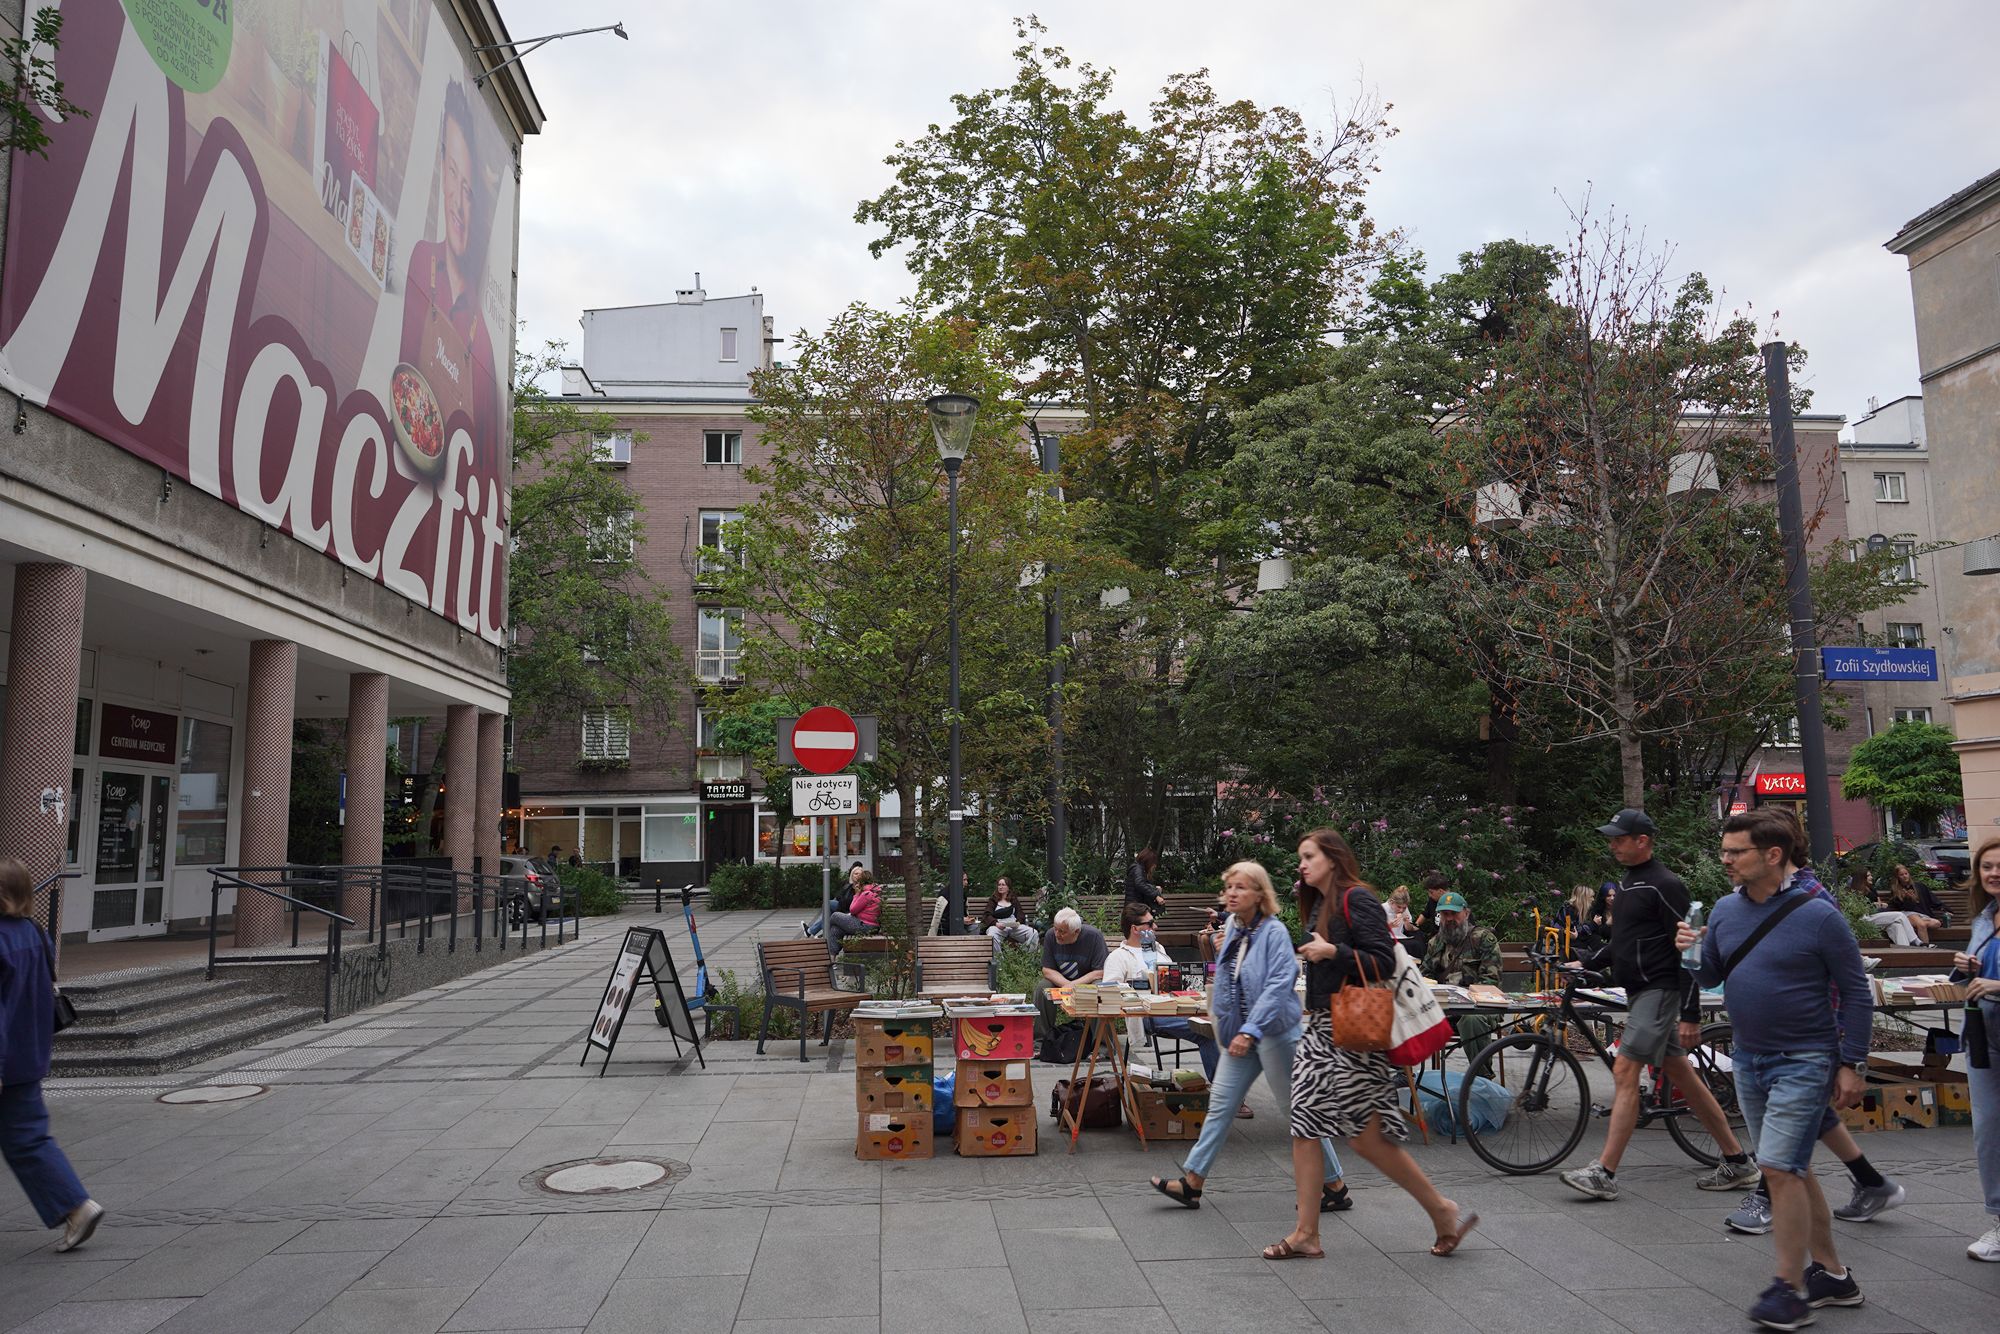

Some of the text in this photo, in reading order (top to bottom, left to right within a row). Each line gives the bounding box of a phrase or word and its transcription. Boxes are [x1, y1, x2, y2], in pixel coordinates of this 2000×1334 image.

[153, 29, 201, 72] SMART START
[198, 36, 212, 54] DLA
[156, 46, 169, 62] OD
[0, 0, 504, 646] Maczfit
[1835, 659, 1931, 677] Zofii Szydłowskiej
[110, 736, 166, 753] CENTRUM MEDYCZNE
[706, 785, 745, 793] TATTOO
[796, 779, 852, 790] Nie dotyczy
